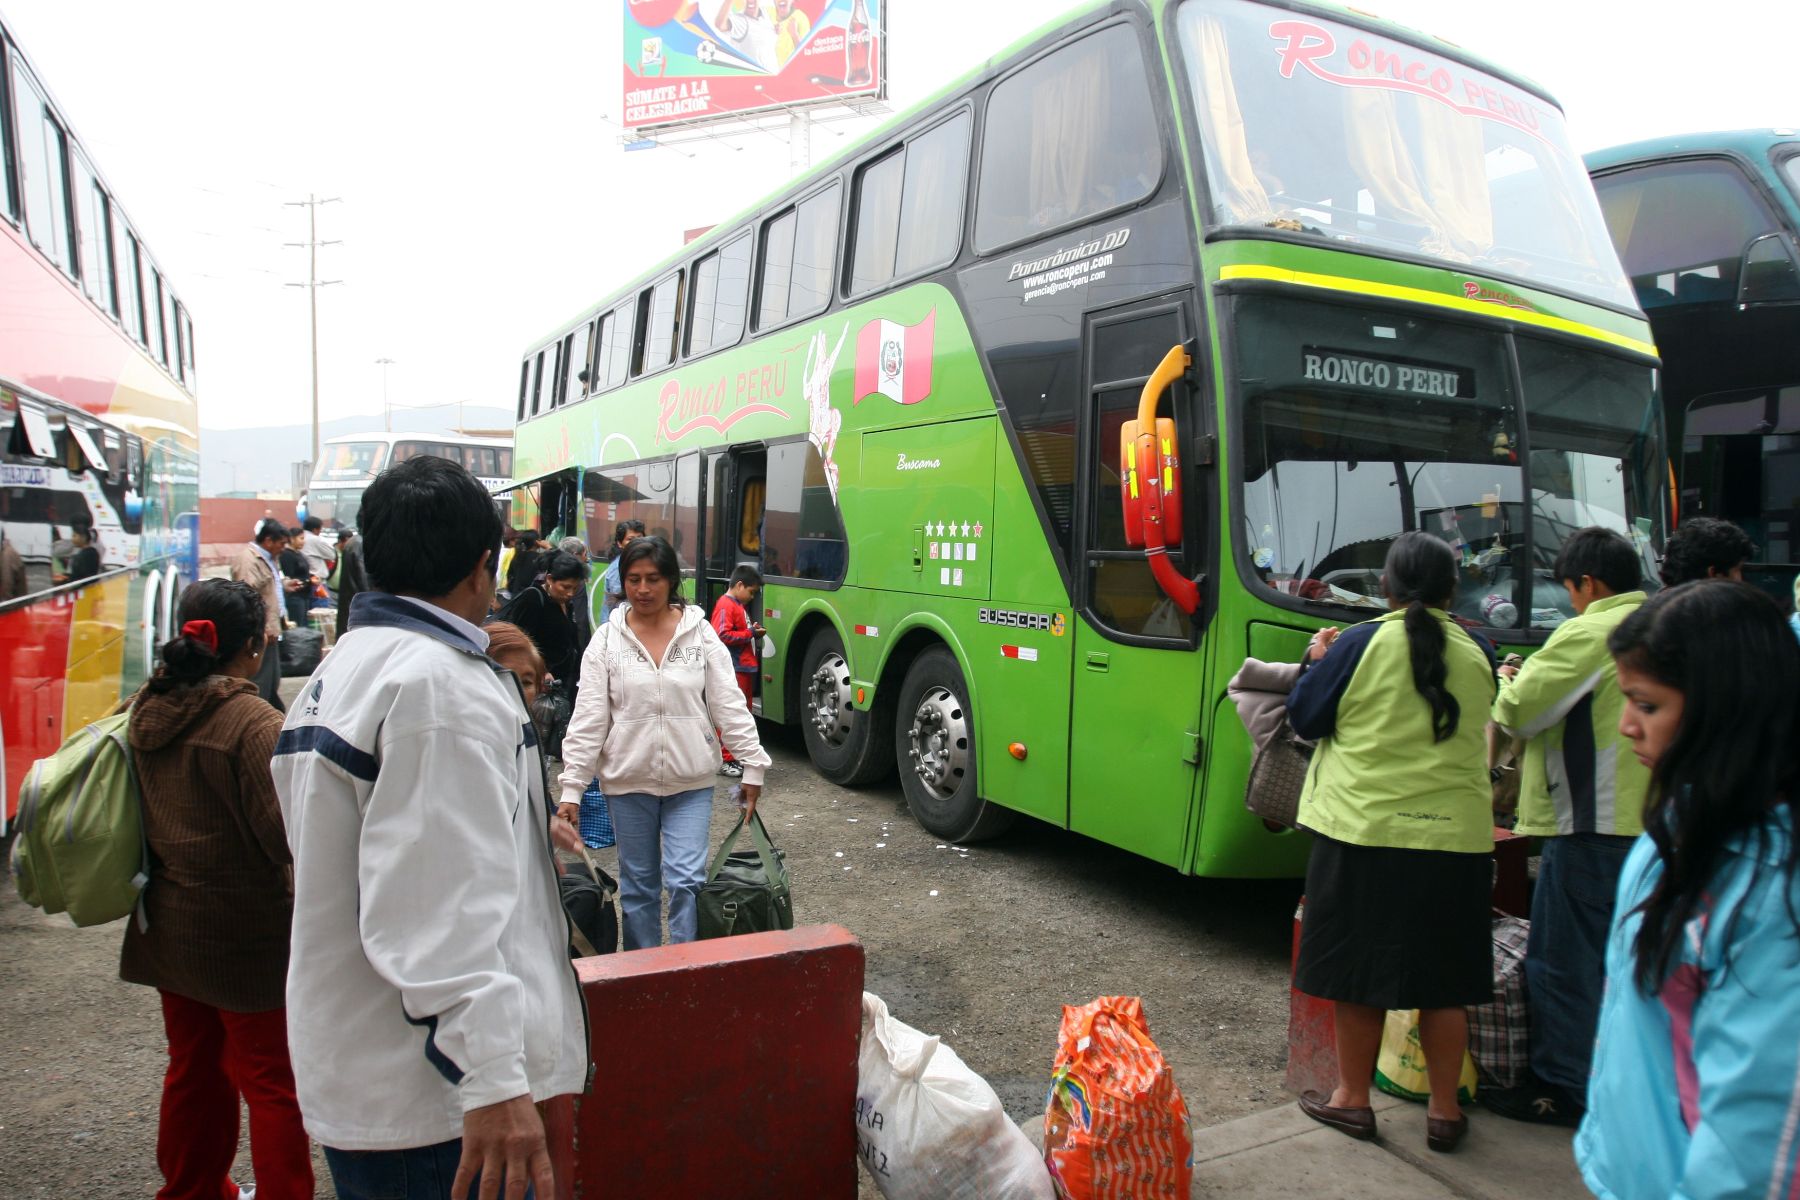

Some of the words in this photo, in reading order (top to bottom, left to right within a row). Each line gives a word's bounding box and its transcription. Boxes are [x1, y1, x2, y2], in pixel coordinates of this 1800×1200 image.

[1268, 20, 1455, 95] Ronco
[625, 86, 676, 107] SÚMATE
[679, 83, 689, 99] A
[691, 80, 709, 96] LA
[1101, 228, 1131, 252] DD
[1023, 253, 1113, 289] www.roncoperu.com
[1304, 354, 1390, 389] RONCO
[1396, 366, 1460, 398] PERU
[655, 378, 727, 446] Ronco
[978, 607, 1050, 632] BUSSCAR
